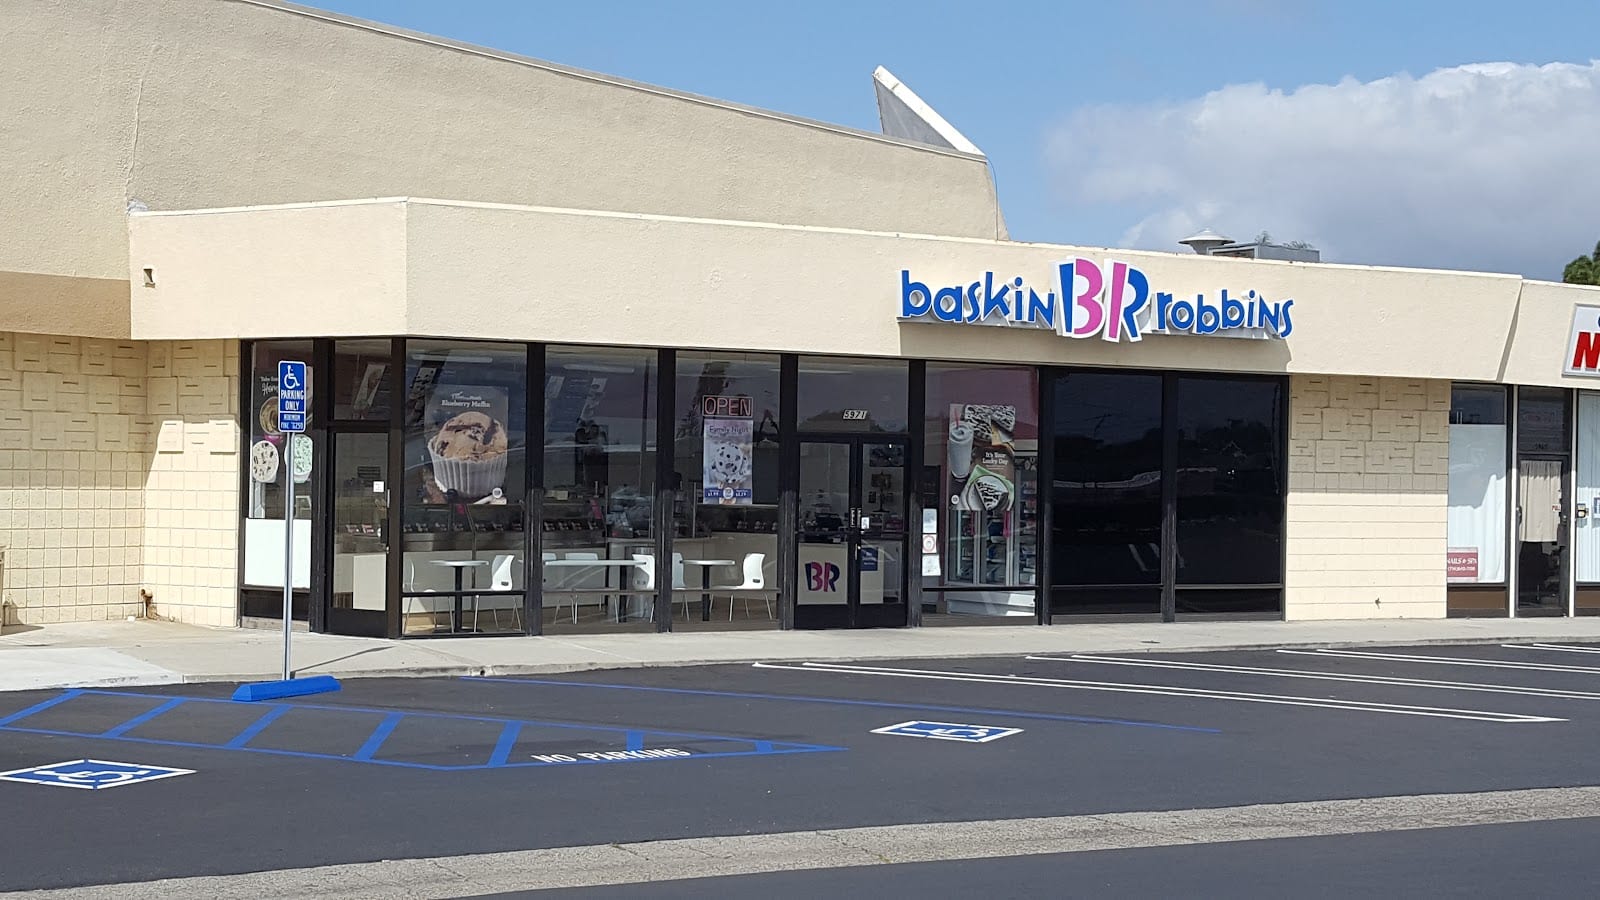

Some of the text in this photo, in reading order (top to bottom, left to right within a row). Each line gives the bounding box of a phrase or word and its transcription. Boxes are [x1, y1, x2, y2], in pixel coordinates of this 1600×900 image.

[900, 257, 1294, 342] baskin BR robbins
[281, 390, 304, 400] PARKING
[285, 401, 300, 410] ONLY
[705, 397, 751, 416] OPEN
[709, 426, 749, 434] Family Night
[805, 562, 840, 592] BR
[531, 748, 691, 763] NO PARKING
